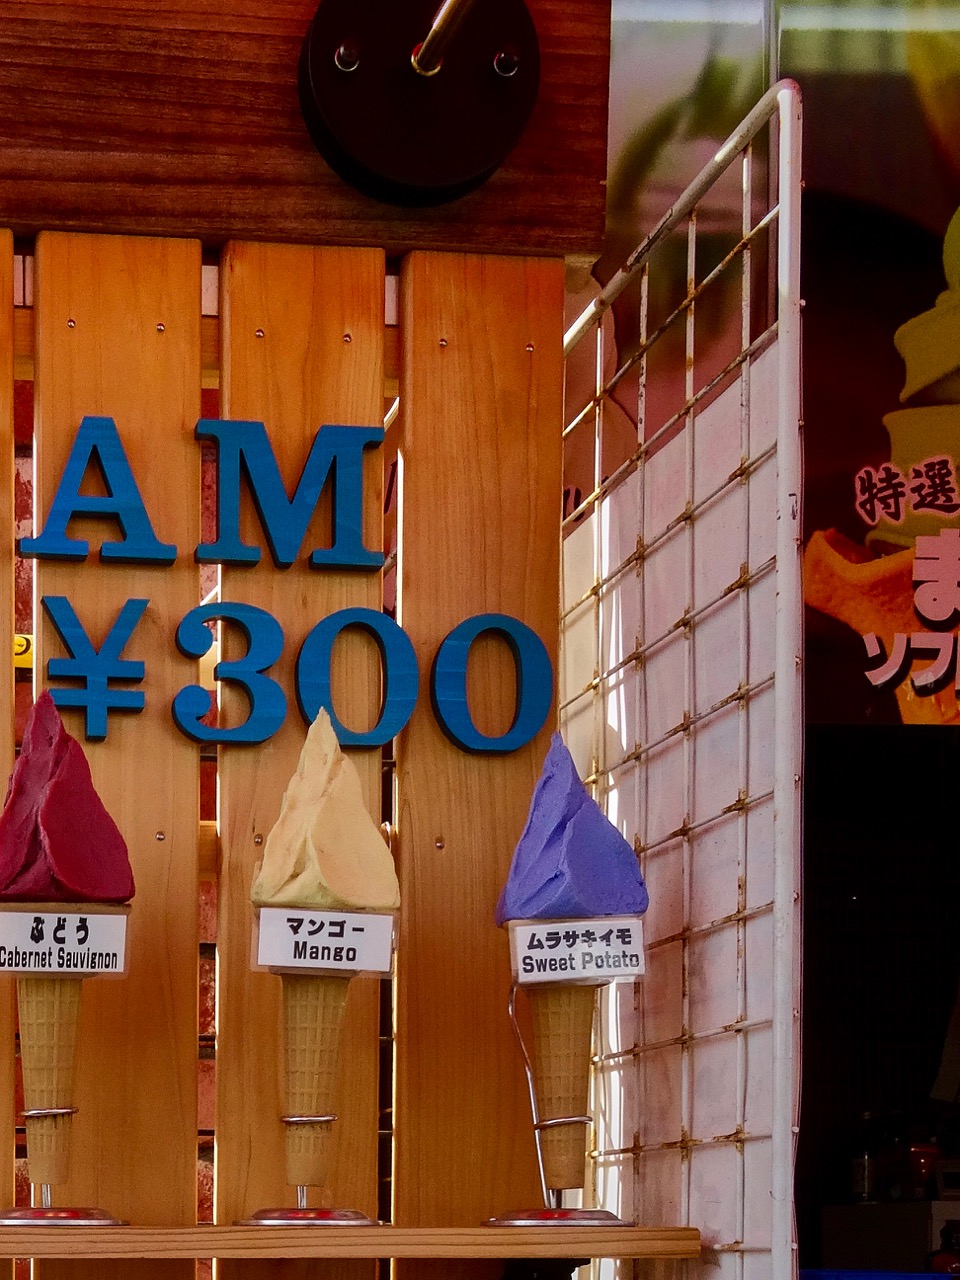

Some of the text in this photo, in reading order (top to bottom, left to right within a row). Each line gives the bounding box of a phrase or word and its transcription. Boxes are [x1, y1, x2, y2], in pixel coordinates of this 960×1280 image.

[863, 632, 960, 686] ソフ
[41, 596, 553, 754] ¥300
[29, 916, 90, 945] ぶどう
[286, 917, 365, 938] マンゴー
[526, 928, 633, 950] ムラサキイモ
[57, 947, 118, 969] Sauvignon
[293, 941, 357, 962] Mango
[521, 950, 640, 973] Sweet Potato
